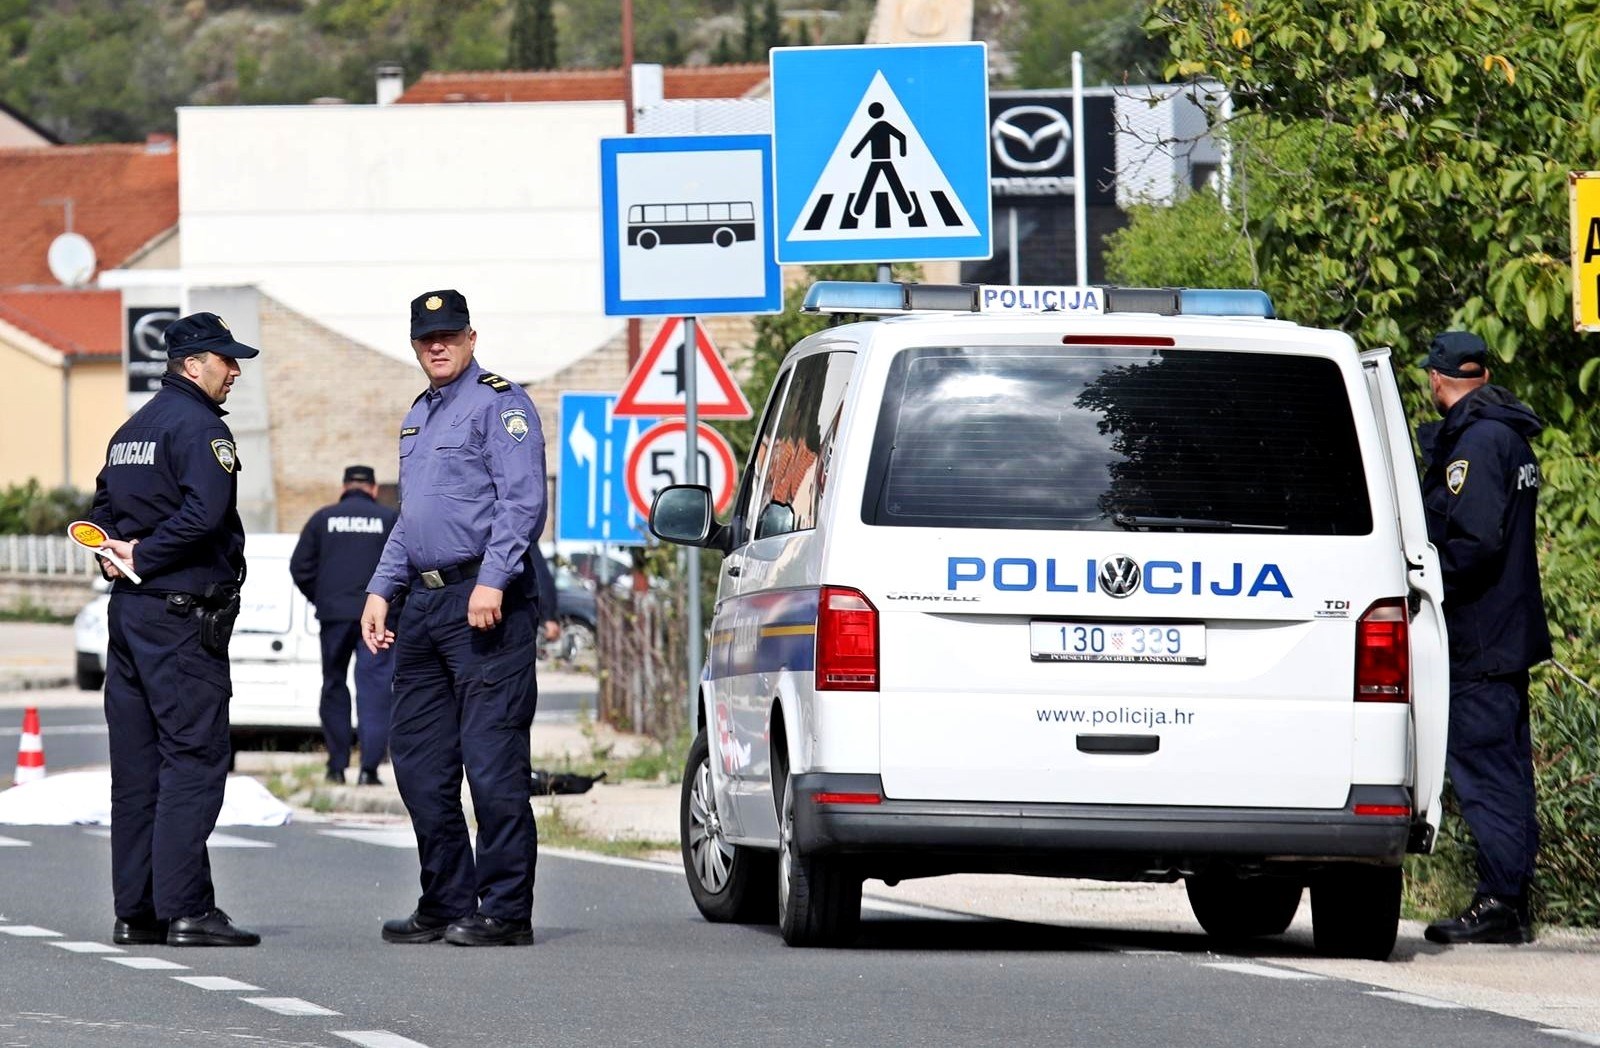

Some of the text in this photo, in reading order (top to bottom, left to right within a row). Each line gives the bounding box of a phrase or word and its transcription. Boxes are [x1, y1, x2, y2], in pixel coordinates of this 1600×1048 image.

[984, 289, 1099, 310] POLICIJA
[108, 441, 157, 467] POLICIJA
[327, 516, 383, 534] POLICIJA
[1324, 600, 1350, 609] TDI
[1060, 626, 1181, 654] 130 339
[1036, 707, 1195, 728] www.policija.hr
